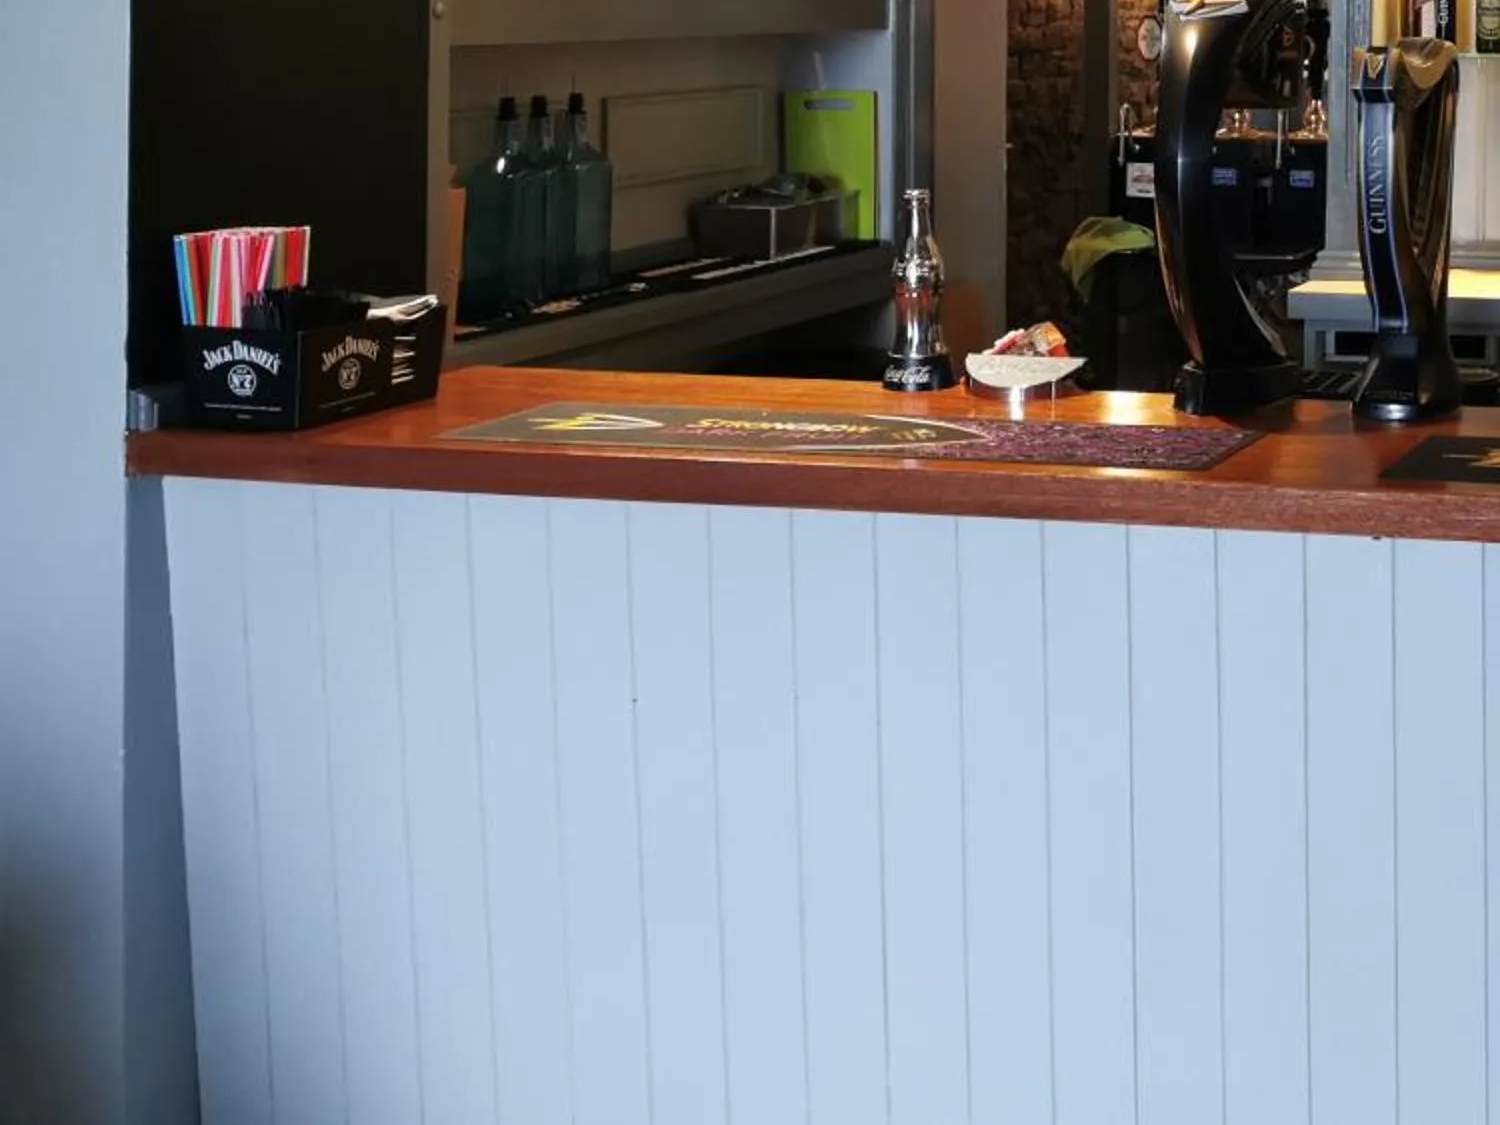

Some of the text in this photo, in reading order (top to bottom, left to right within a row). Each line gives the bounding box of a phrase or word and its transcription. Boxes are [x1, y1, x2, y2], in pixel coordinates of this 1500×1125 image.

[1368, 134, 1388, 236] GUINNESS
[202, 344, 233, 372] JACK
[320, 338, 347, 373] JACK
